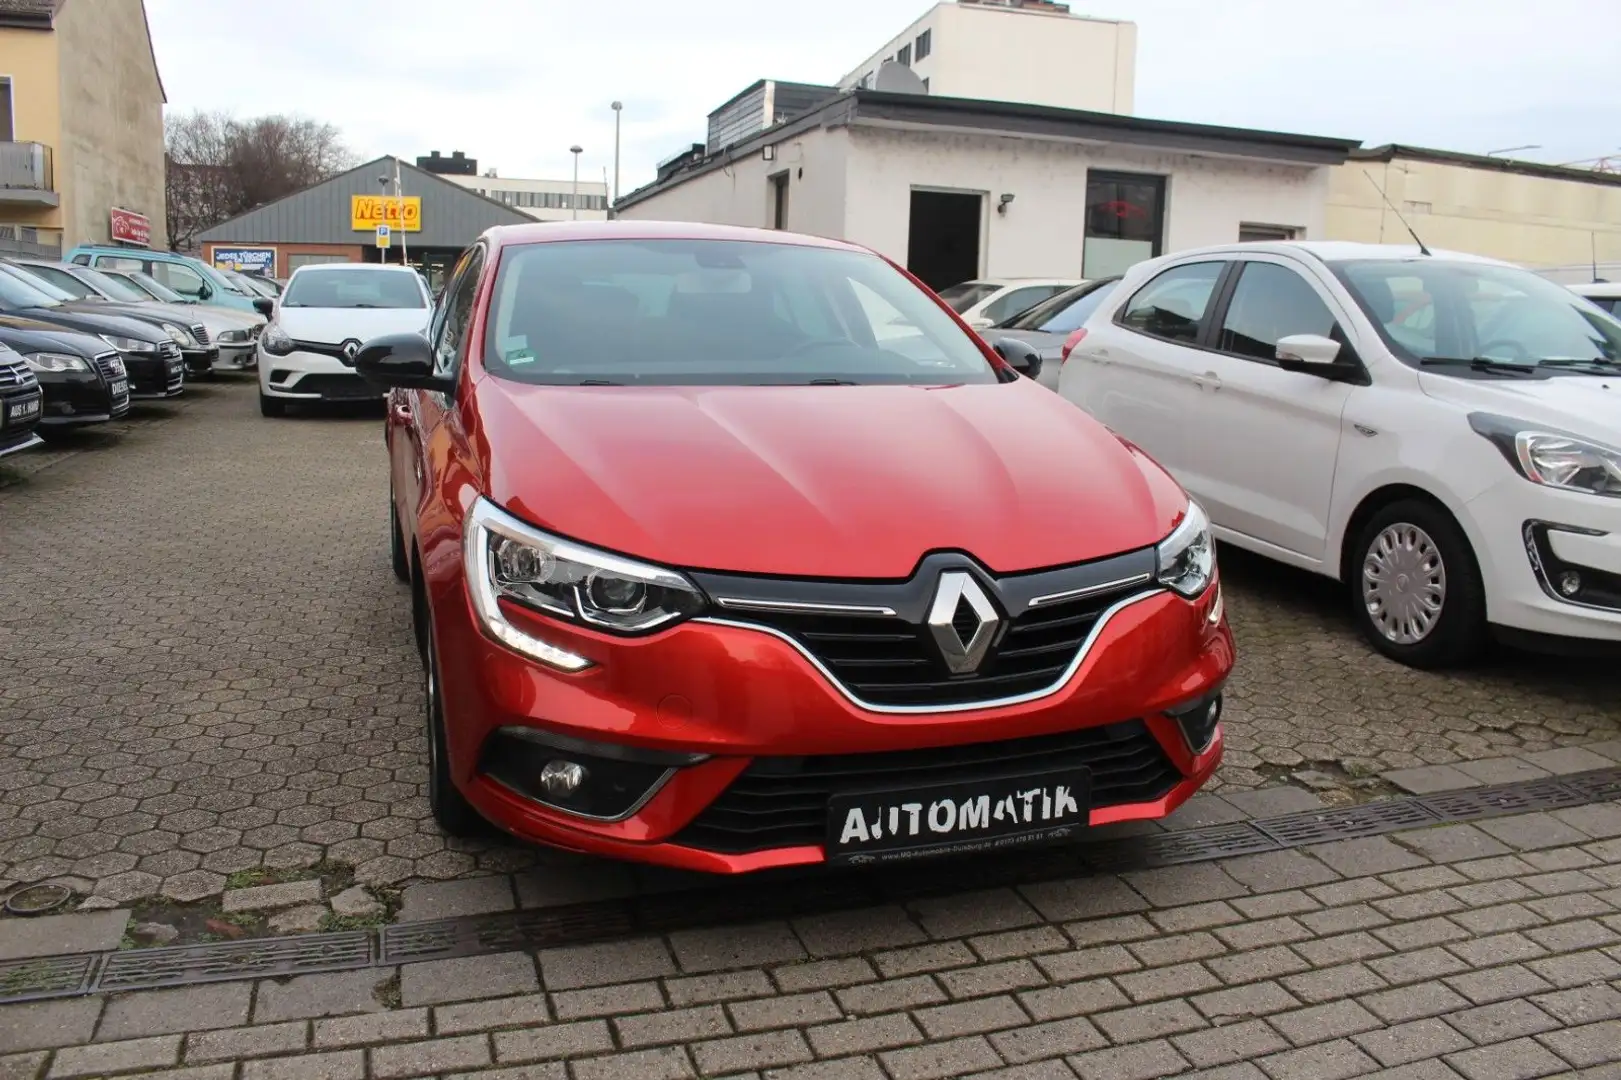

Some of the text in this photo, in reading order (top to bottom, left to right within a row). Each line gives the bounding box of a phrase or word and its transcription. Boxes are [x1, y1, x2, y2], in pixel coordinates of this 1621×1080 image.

[355, 199, 418, 220] Netto
[10, 404, 22, 418] AUS
[839, 785, 1078, 844] AUTOMATIK
